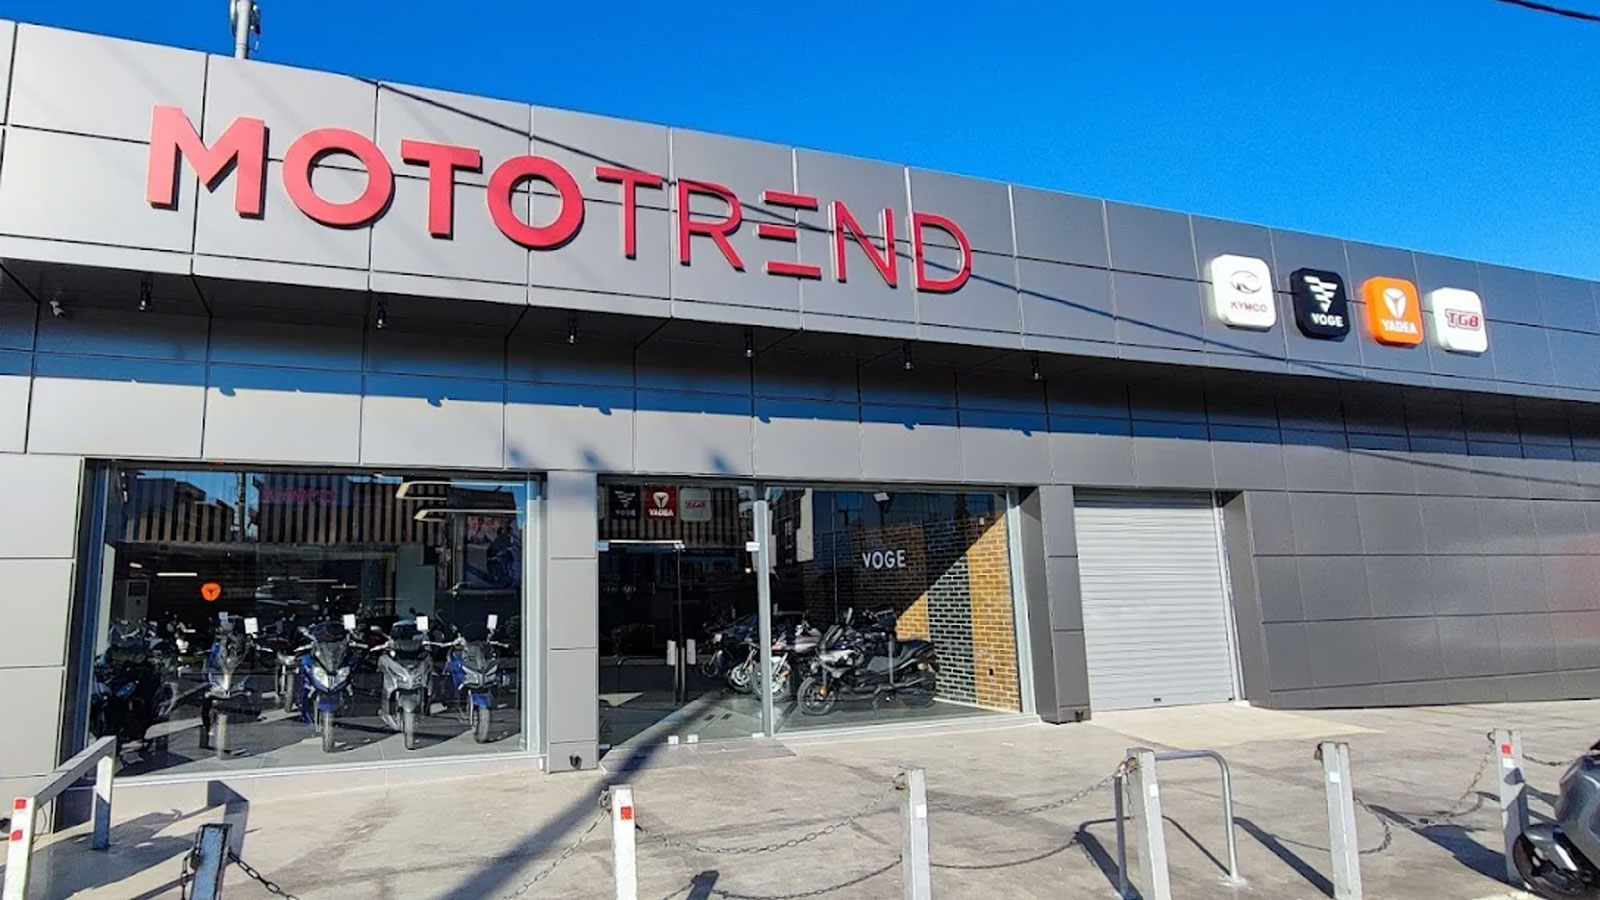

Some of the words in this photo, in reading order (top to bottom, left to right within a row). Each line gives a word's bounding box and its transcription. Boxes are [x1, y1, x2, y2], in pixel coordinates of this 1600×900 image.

[146, 104, 972, 294] MOTOTREND
[1230, 300, 1268, 313] KYMCO
[1311, 312, 1344, 328] VOGE
[1381, 318, 1418, 335] YADEA
[1445, 308, 1481, 331] TGB
[648, 508, 674, 516] YADEA
[862, 549, 906, 569] VOGE
